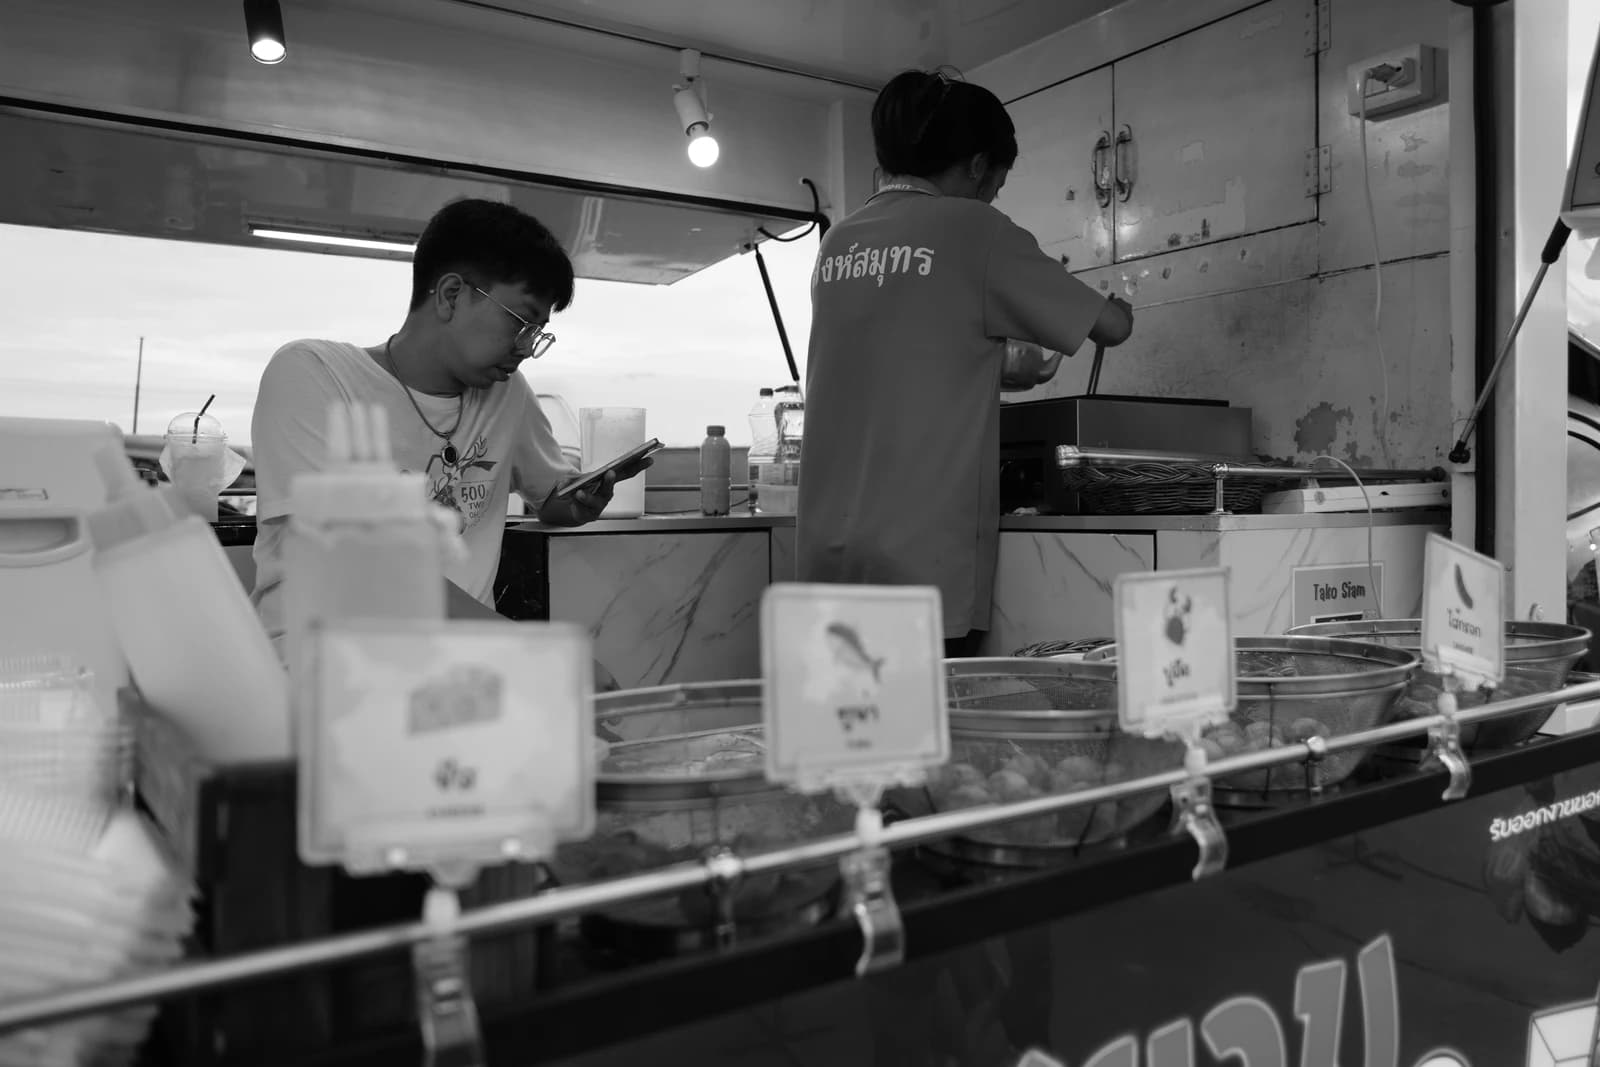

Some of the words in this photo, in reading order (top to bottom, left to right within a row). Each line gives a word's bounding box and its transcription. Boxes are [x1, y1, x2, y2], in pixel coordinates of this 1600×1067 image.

[461, 484, 485, 503] 500
[1313, 583, 1337, 601] Tako
[1341, 581, 1366, 599] Siam
